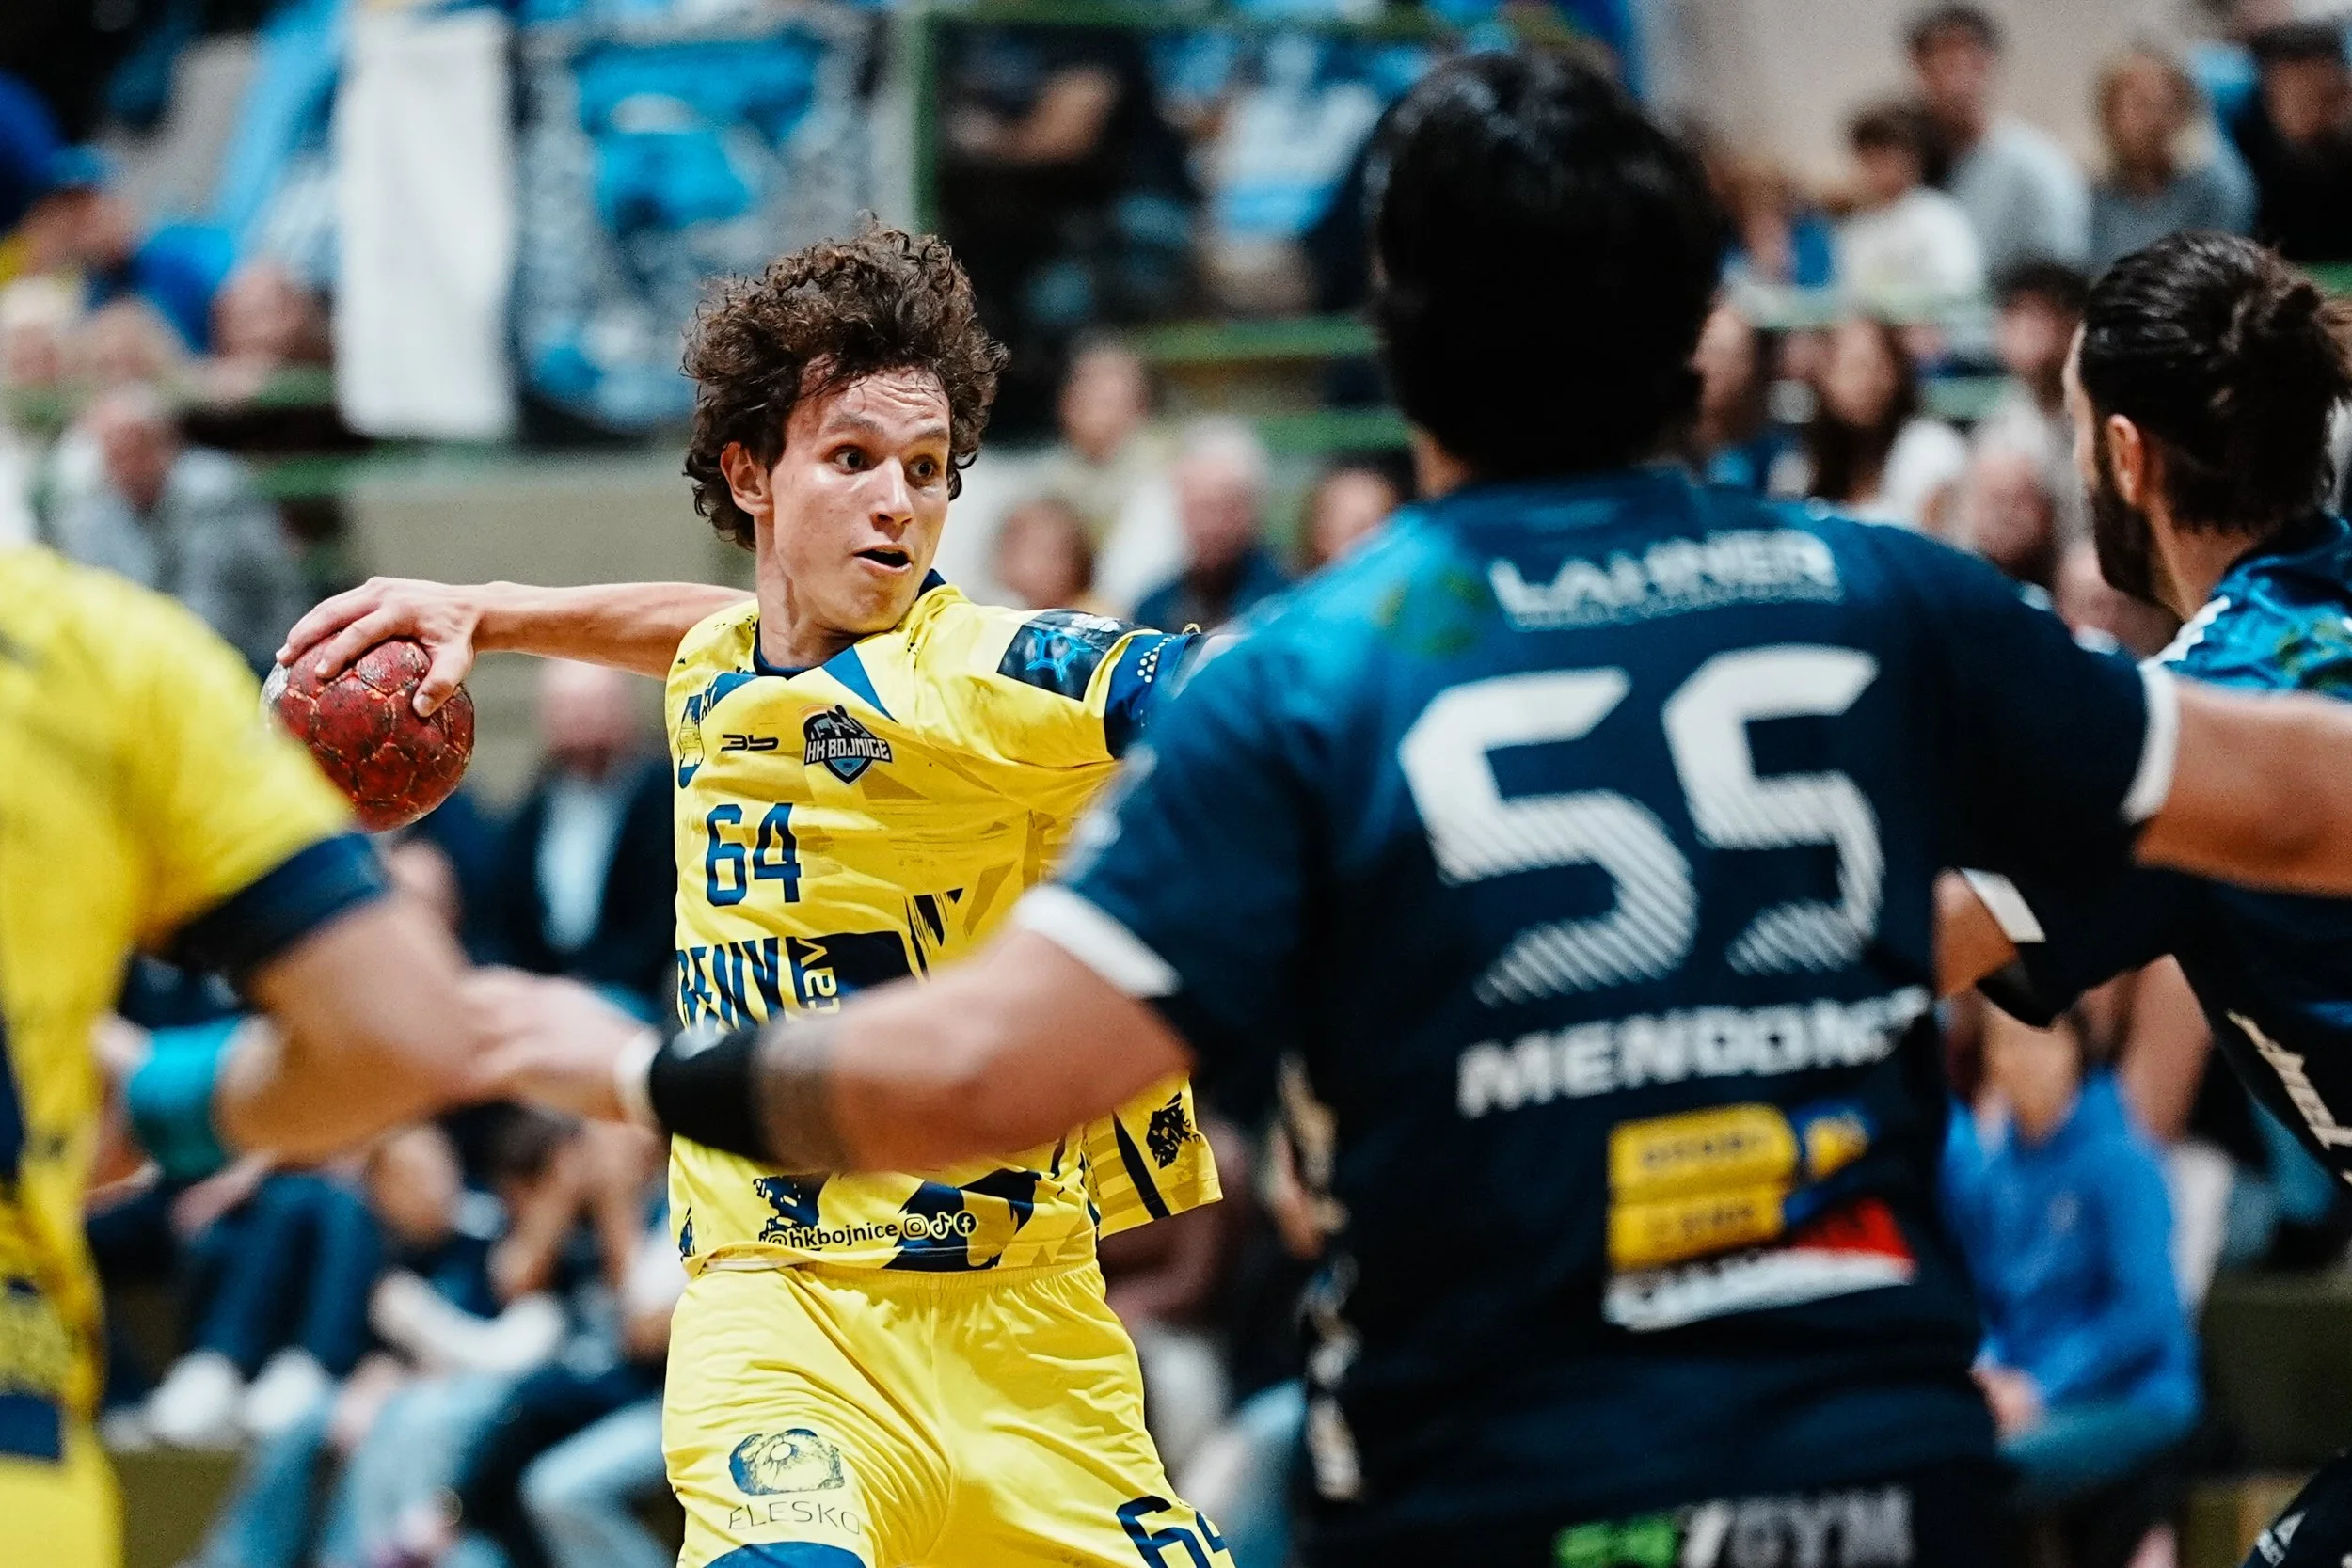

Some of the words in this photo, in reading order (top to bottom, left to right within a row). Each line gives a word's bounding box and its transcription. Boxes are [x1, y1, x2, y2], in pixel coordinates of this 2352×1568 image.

[805, 740, 826, 764] HK
[827, 737, 890, 760] BOJNICE
[1397, 643, 1885, 1008] 55
[705, 802, 802, 908] 64
[768, 1223, 898, 1249] @hkbojnice
[728, 1500, 860, 1536] ELESKO
